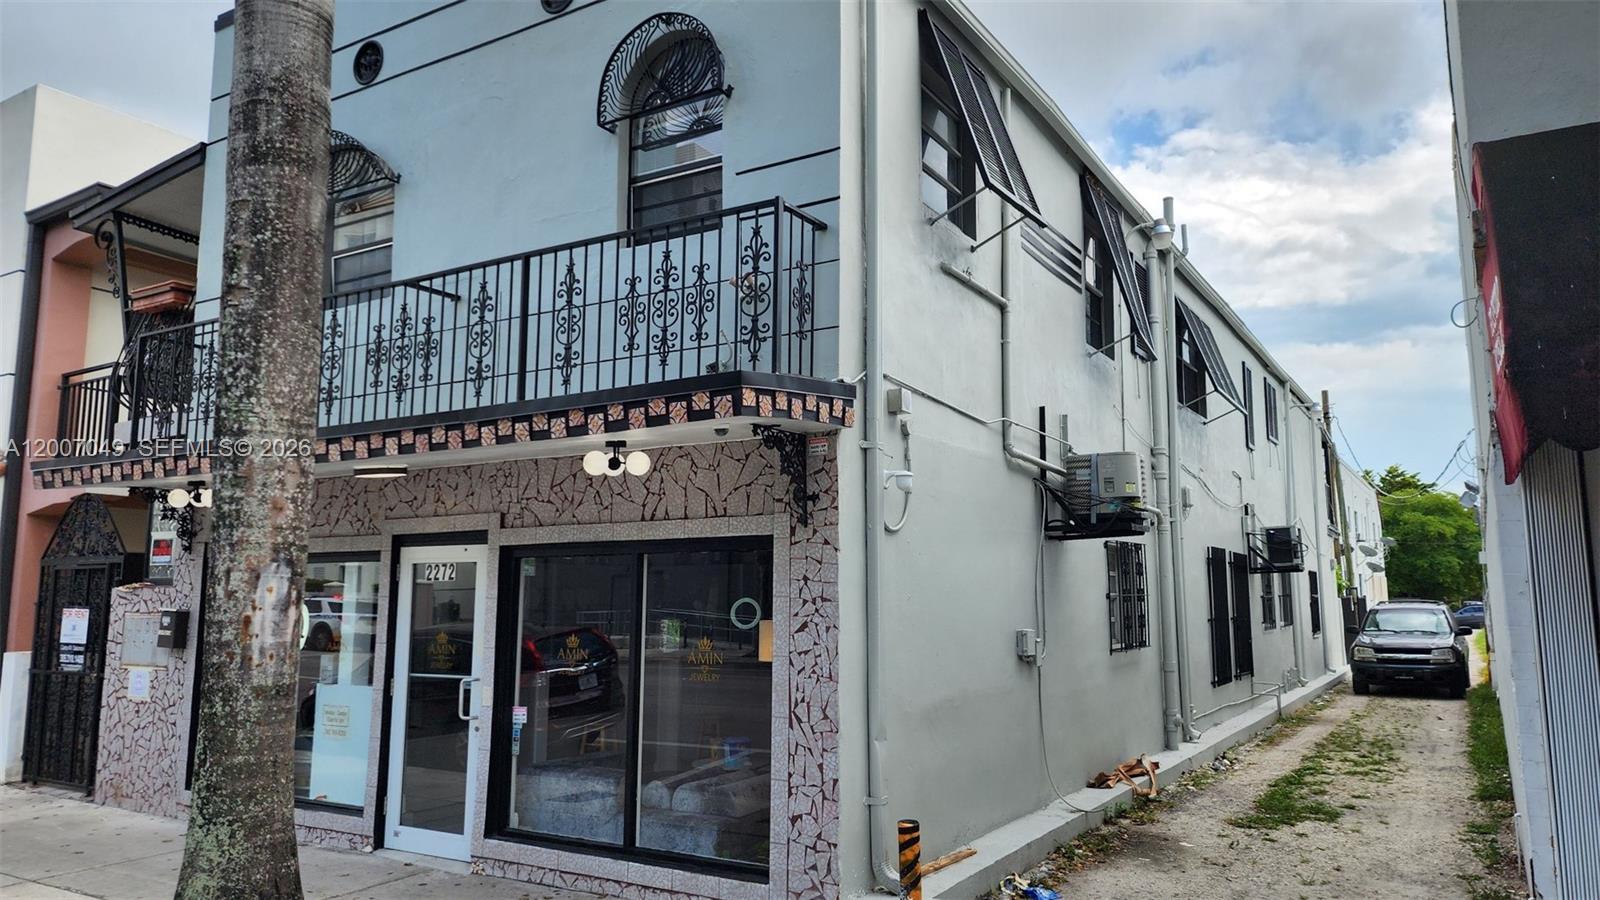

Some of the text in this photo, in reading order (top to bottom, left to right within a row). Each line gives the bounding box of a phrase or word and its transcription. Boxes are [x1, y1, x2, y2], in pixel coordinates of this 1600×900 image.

[426, 563, 456, 581] 2272
[556, 647, 590, 661] AMIN
[687, 651, 724, 665] AMIN
[688, 672, 721, 681] JEWELRY
